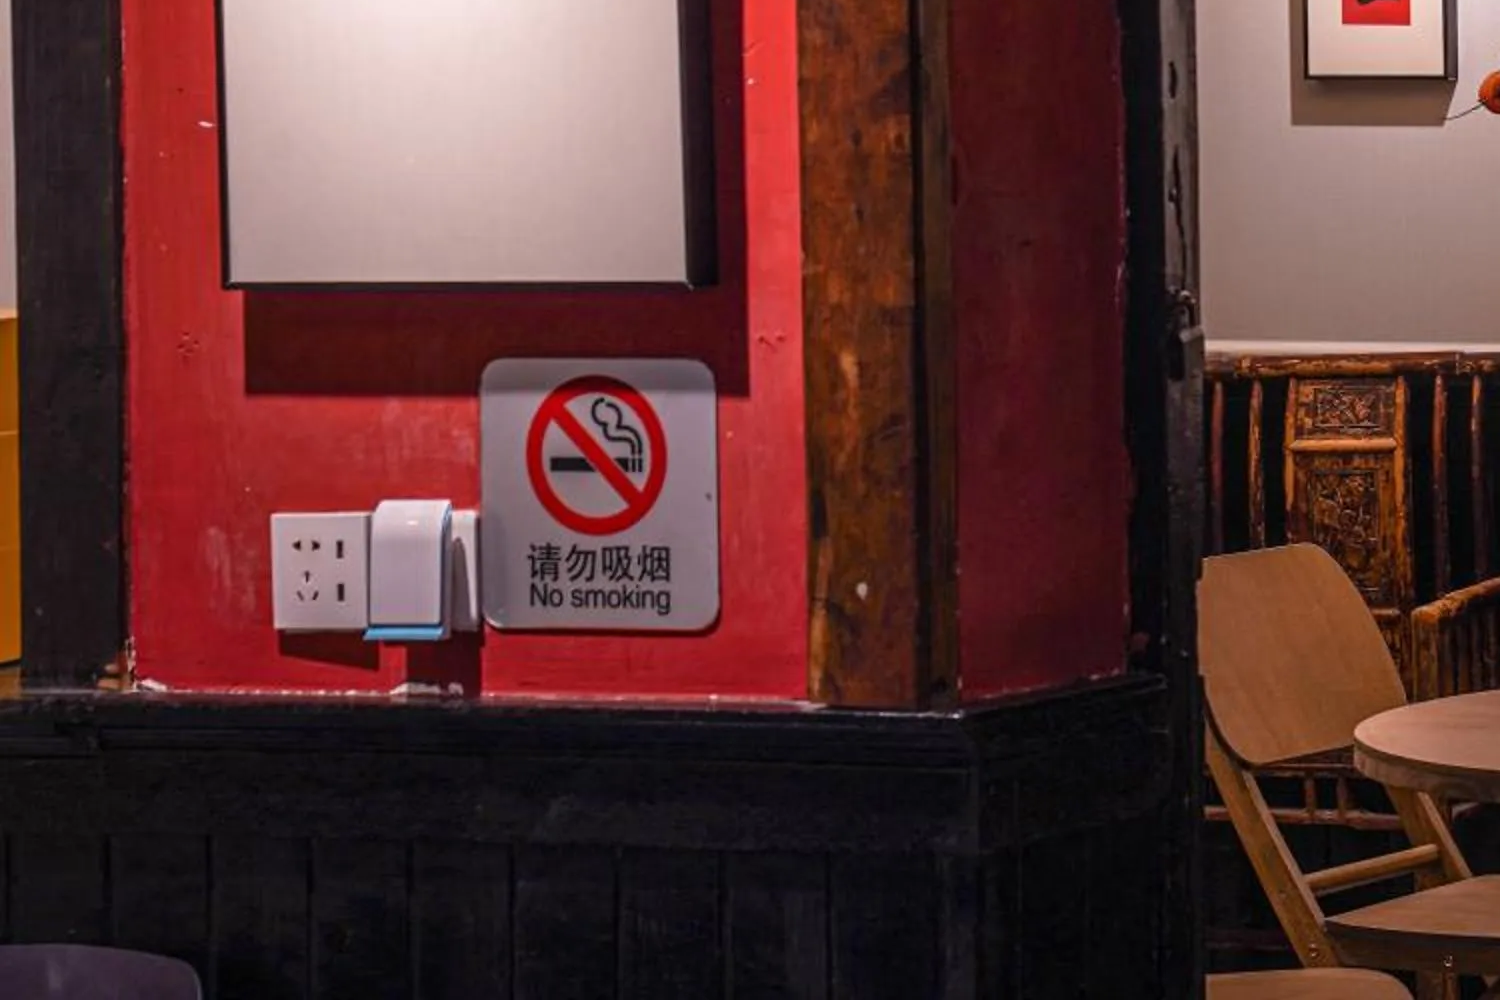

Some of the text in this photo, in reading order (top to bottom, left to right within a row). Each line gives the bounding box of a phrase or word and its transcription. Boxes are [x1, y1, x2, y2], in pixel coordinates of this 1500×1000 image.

[528, 543, 671, 583] 请勿吸烟
[529, 583, 671, 616] No smoking
